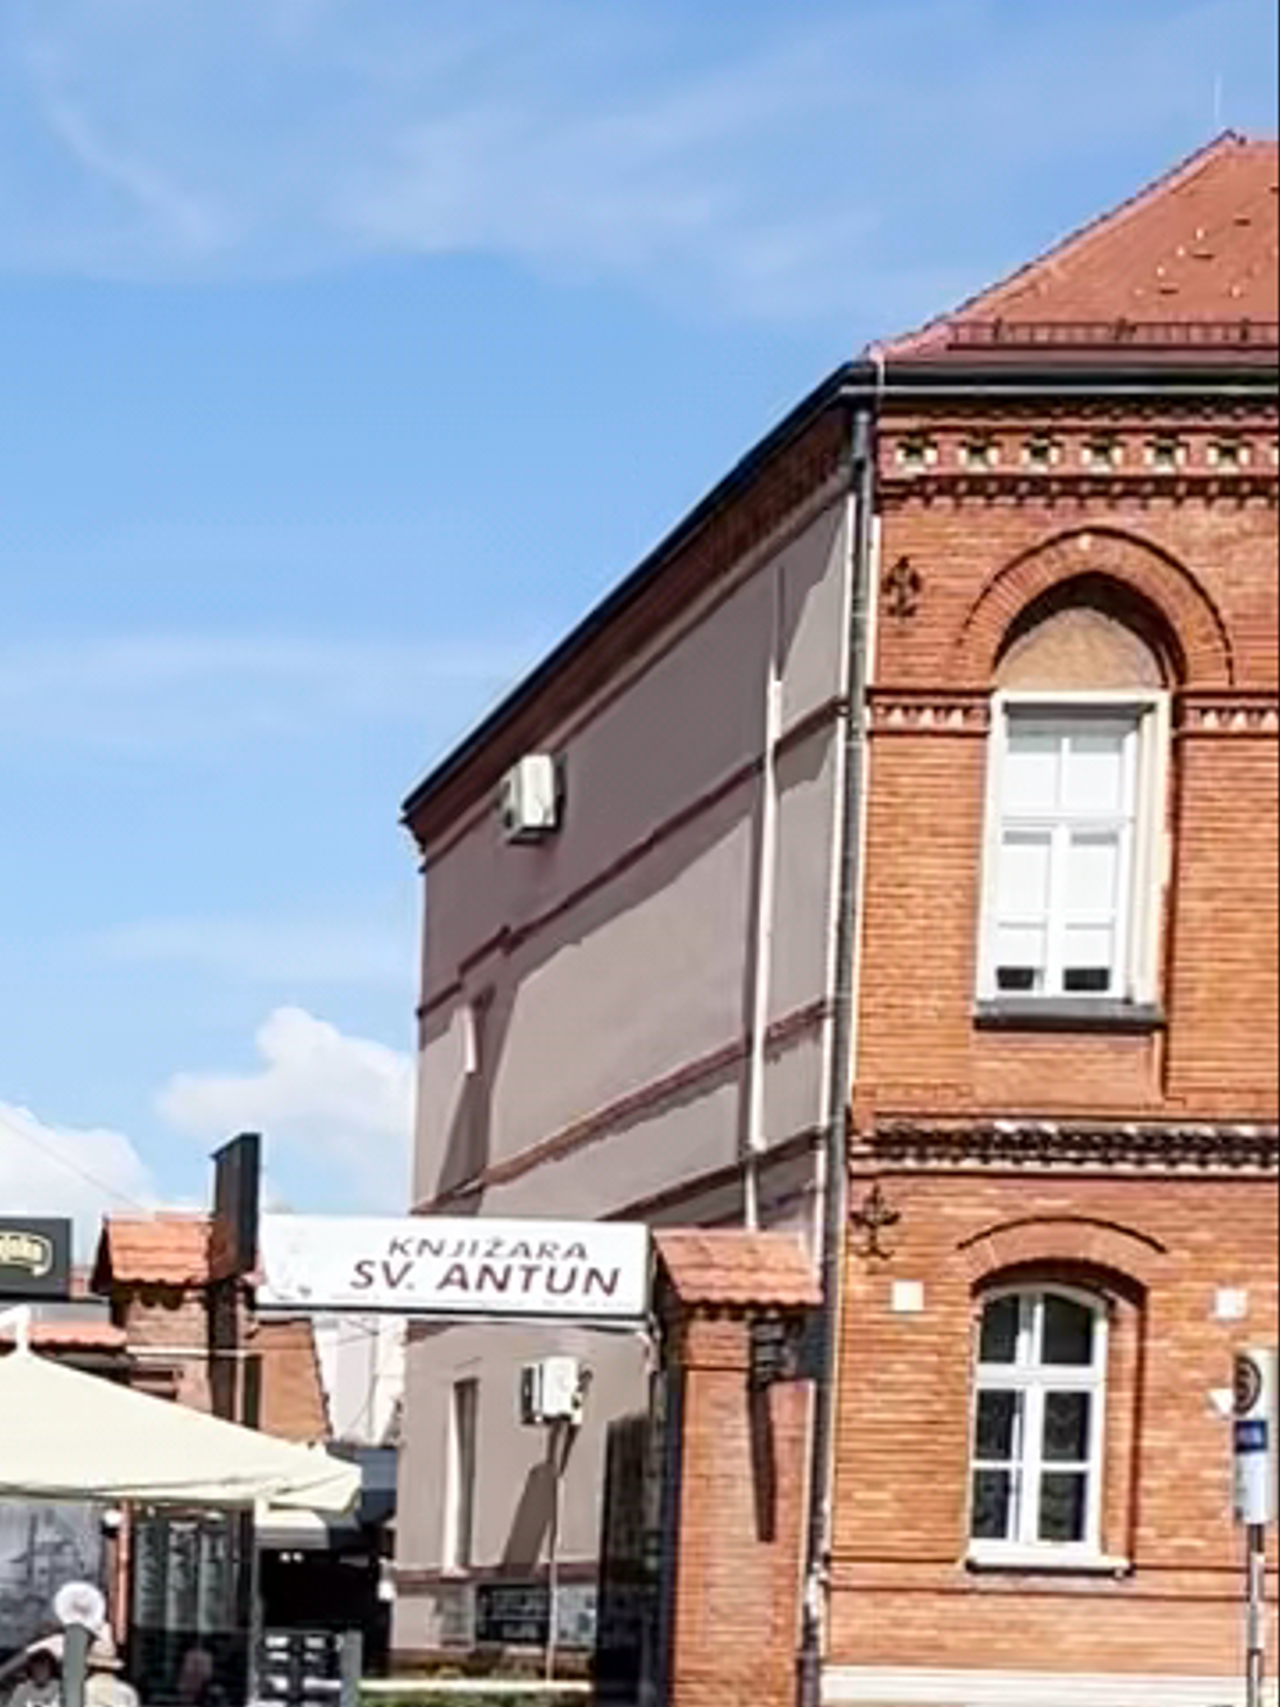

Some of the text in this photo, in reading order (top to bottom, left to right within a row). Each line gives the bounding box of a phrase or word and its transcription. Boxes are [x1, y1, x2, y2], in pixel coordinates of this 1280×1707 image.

[388, 1236, 588, 1261] KNJIŽARA
[349, 1259, 622, 1297] SV. ANTUN
